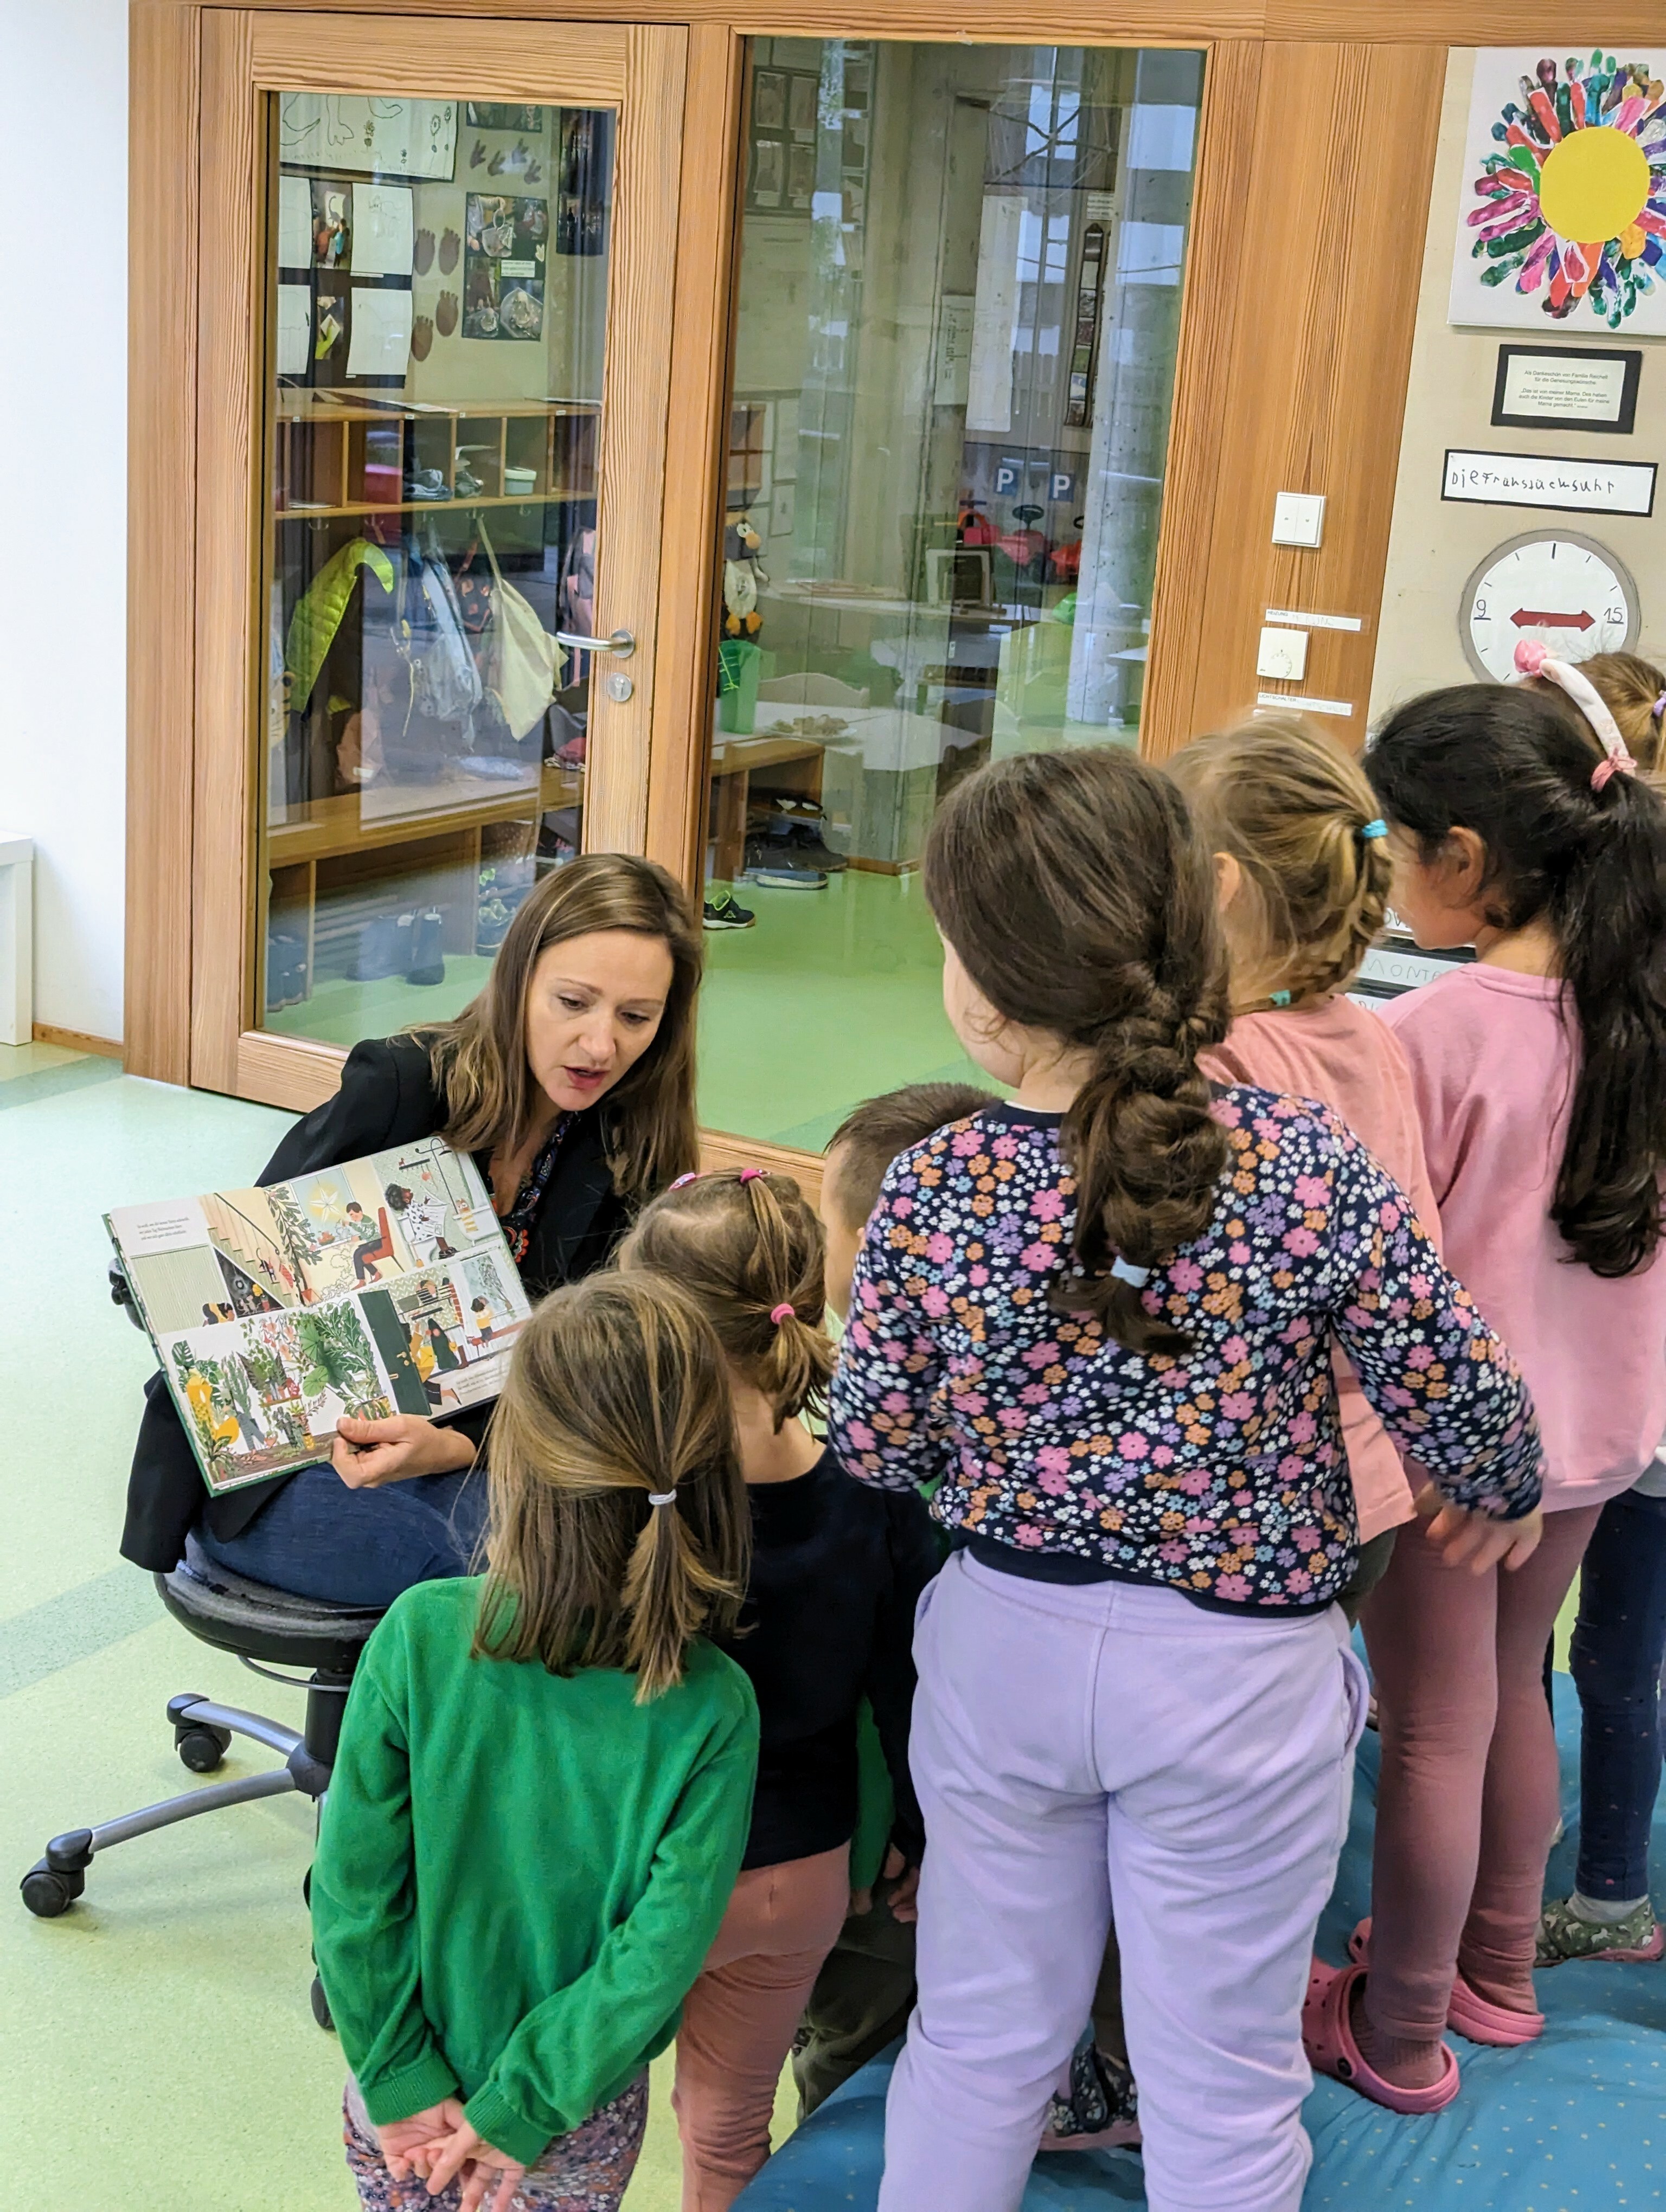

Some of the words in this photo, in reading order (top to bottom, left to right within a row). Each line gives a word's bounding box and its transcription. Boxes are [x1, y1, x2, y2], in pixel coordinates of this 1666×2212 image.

[997, 468, 1014, 492] P
[1053, 474, 1070, 498] P
[1476, 599, 1486, 617] 9
[1604, 607, 1623, 622] 15
